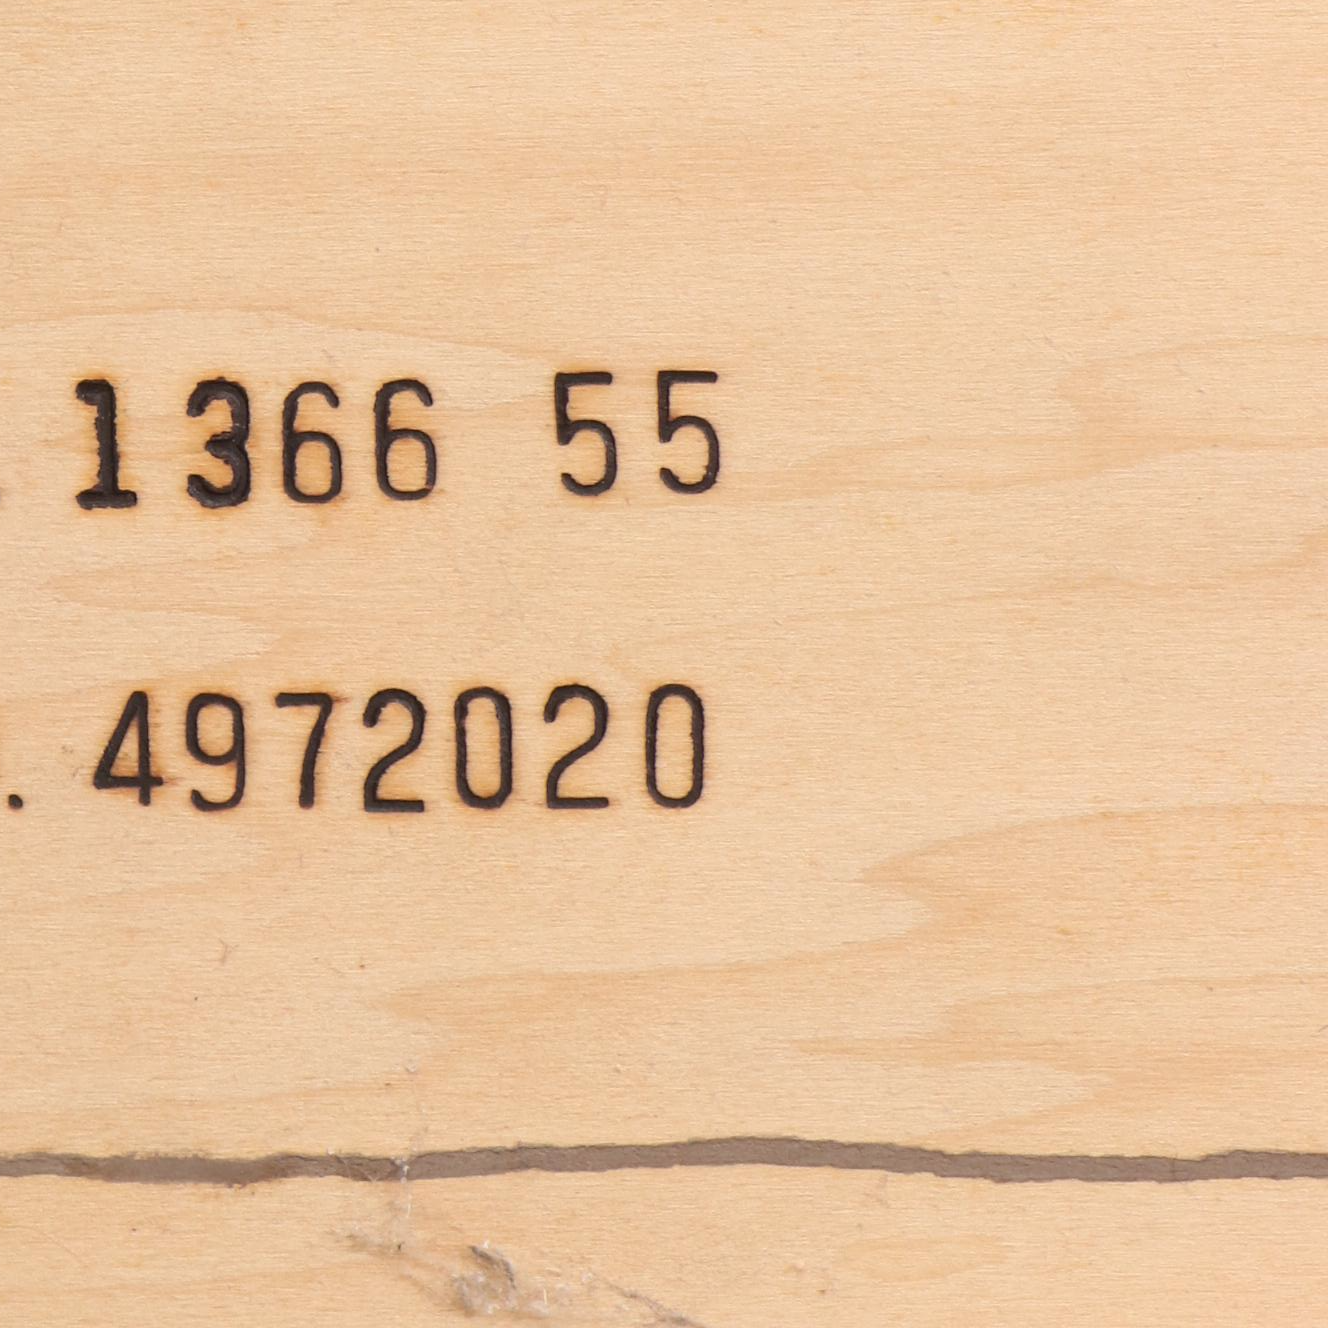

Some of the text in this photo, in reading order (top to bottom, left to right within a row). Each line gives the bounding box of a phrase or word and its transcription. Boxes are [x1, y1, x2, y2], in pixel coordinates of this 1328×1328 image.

[75, 376, 438, 511] 1366
[553, 369, 721, 497] 55
[92, 682, 706, 813] 4972020
